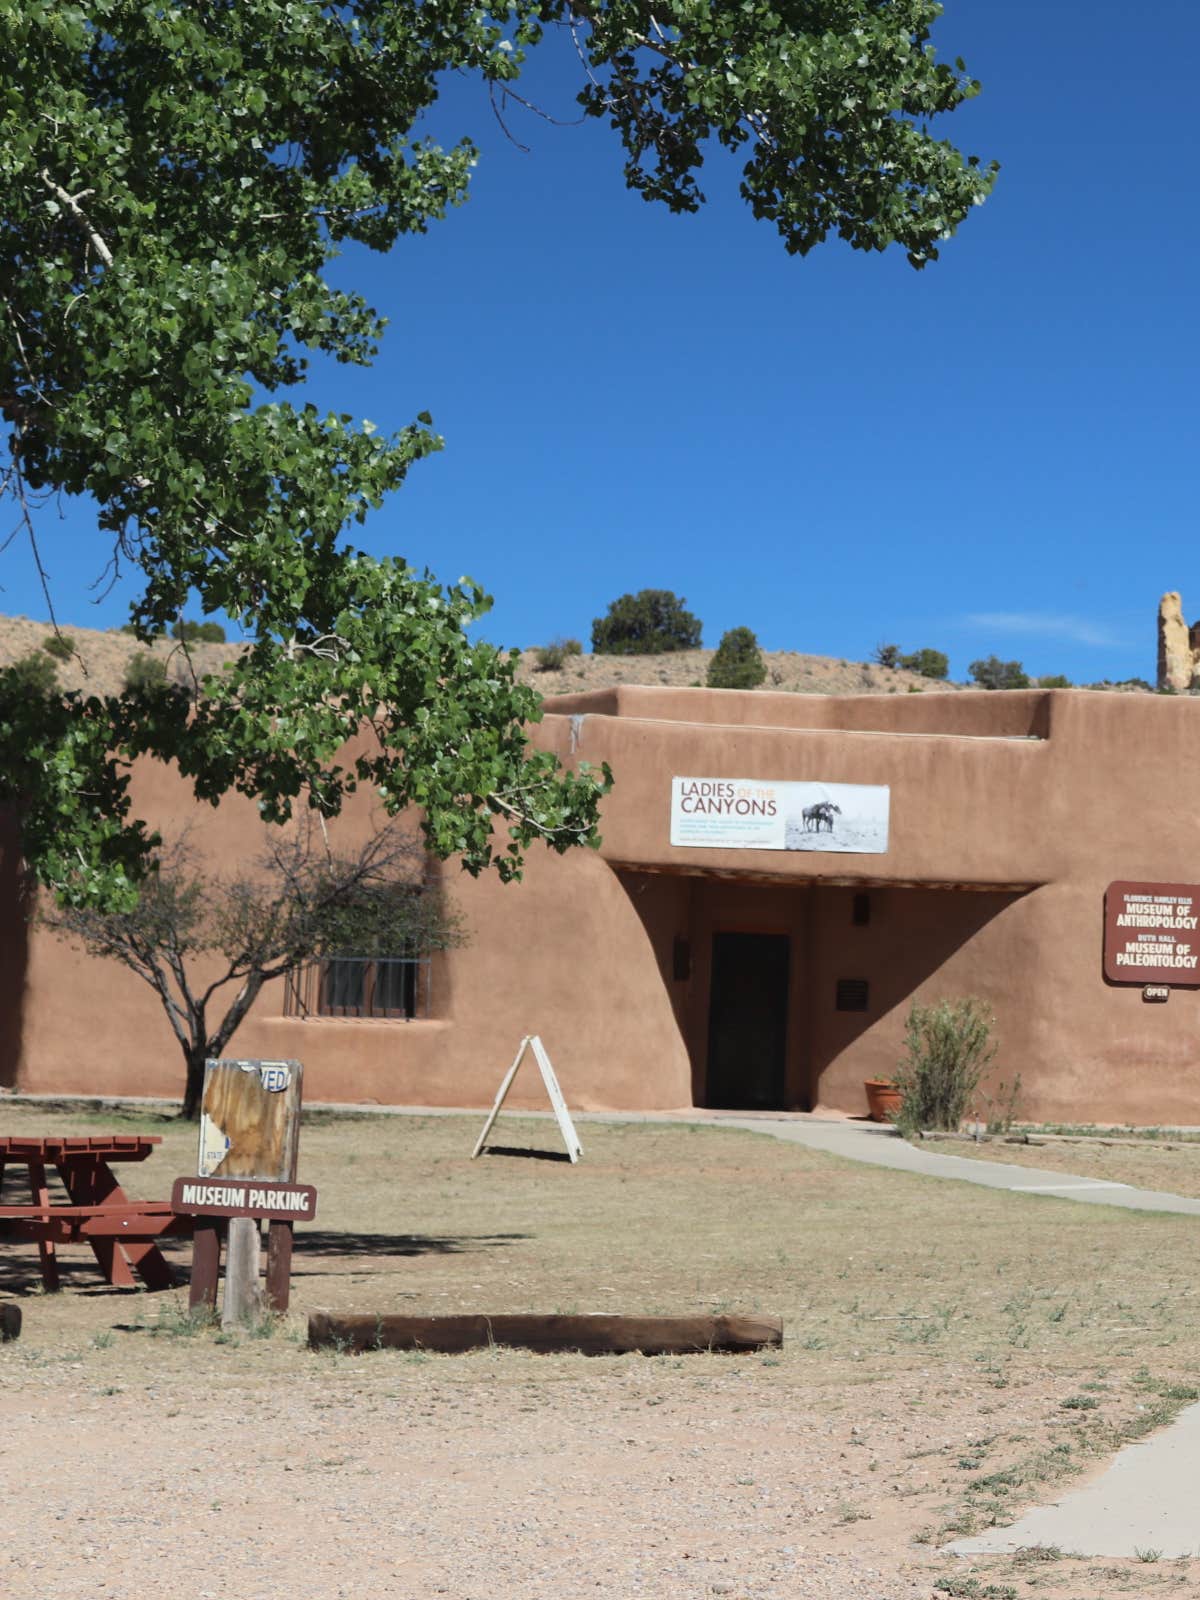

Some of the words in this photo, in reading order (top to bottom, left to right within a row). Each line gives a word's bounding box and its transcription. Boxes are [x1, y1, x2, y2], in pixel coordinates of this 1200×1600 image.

[681, 782, 735, 798] LADIES
[681, 797, 777, 816] CANYONS
[1126, 903, 1173, 915] MUSEUM
[1177, 905, 1190, 916] OF
[1116, 914, 1198, 929] ANTHROPOLOGY
[1125, 942, 1173, 955] MUSEUM
[1176, 944, 1191, 956] OF
[1116, 953, 1198, 968] PALEONTOLOGY
[1146, 988, 1168, 997] OPEN
[182, 1185, 245, 1207] MUSEUM
[248, 1189, 309, 1211] PARKING
